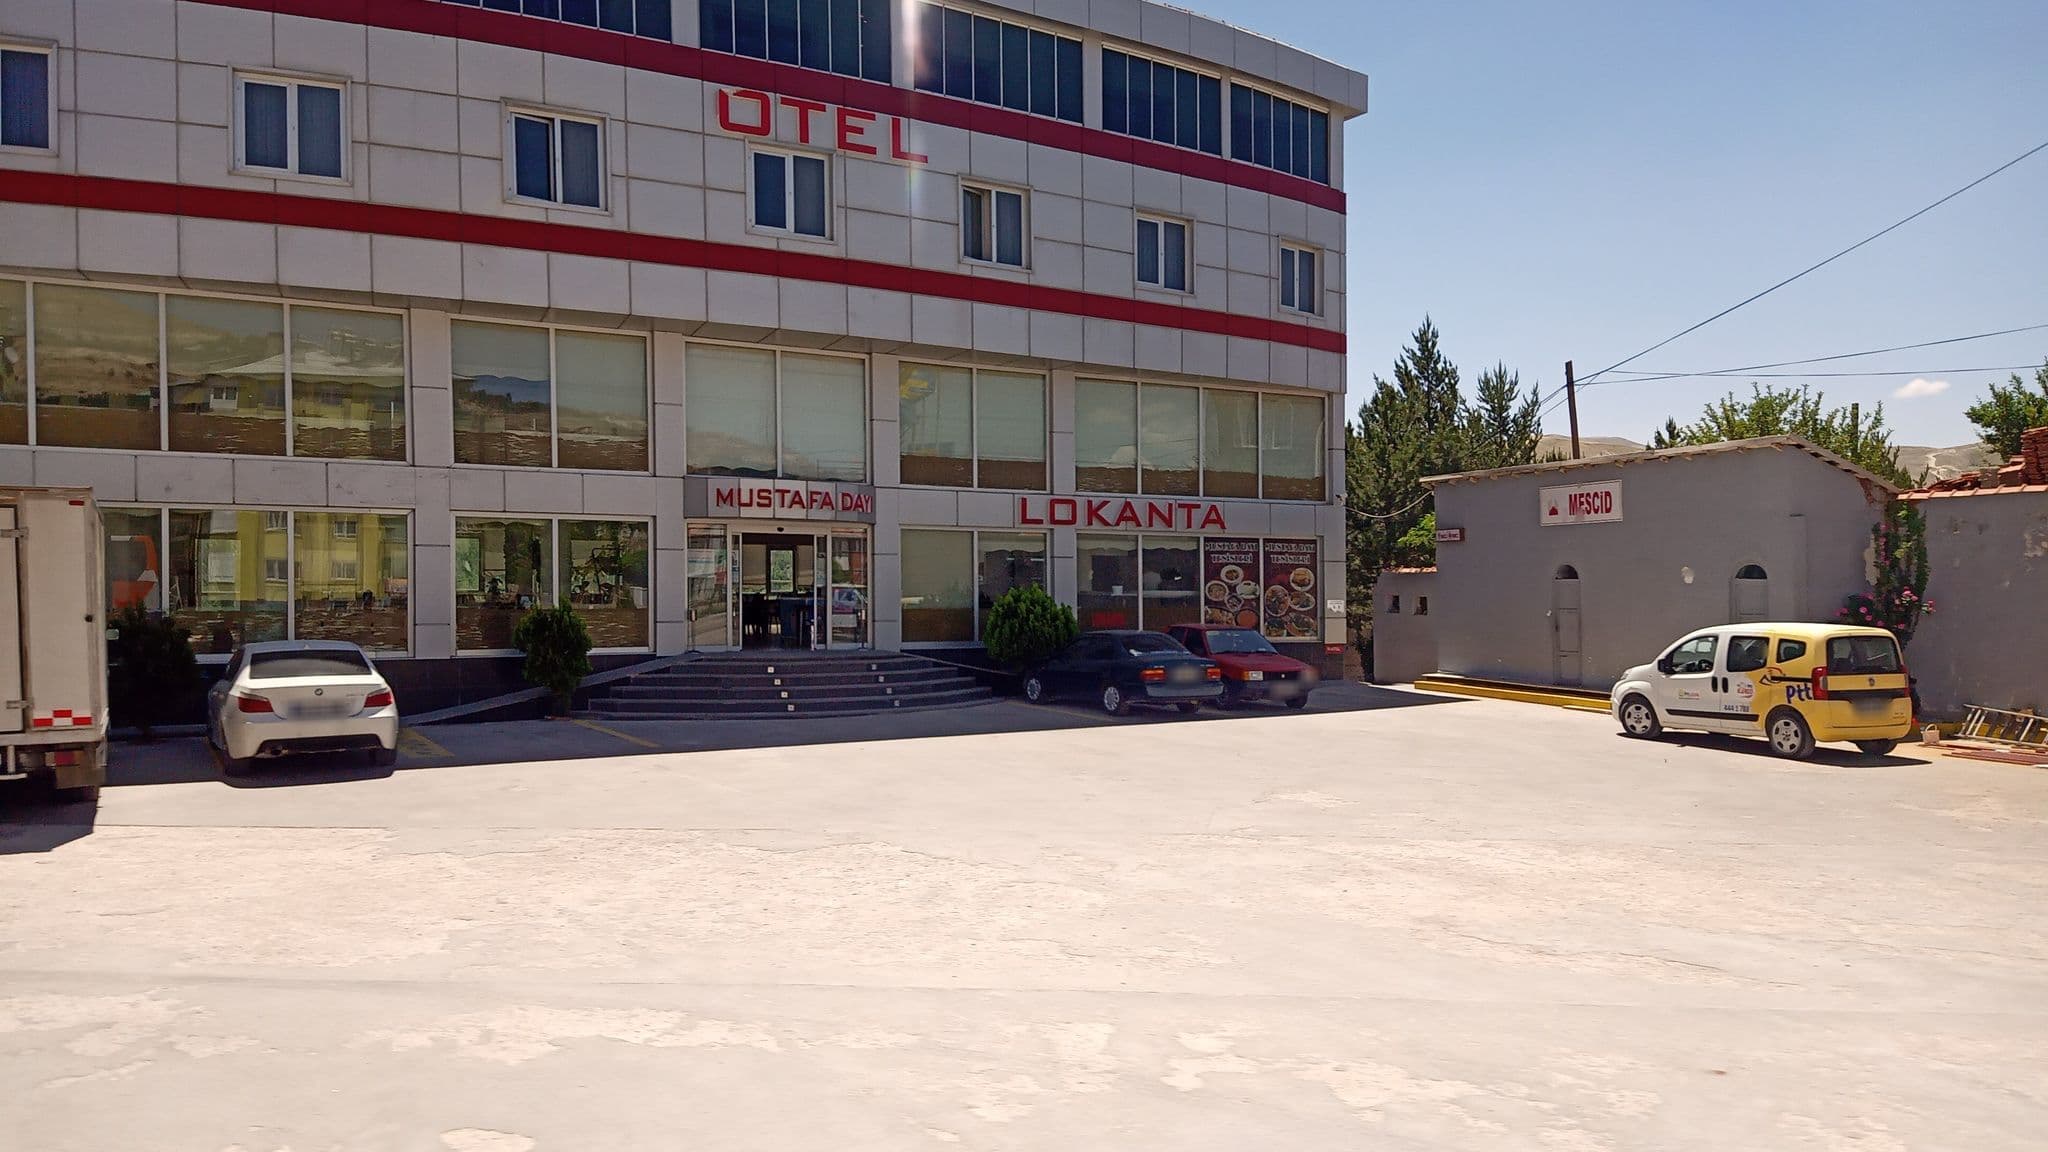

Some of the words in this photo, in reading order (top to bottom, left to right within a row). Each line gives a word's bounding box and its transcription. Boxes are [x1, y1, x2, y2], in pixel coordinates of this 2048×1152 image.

[718, 88, 929, 164] OTEL
[715, 487, 835, 511] MUSTAFA
[840, 492, 873, 513] DAYI
[1019, 497, 1227, 530] LOKANTA
